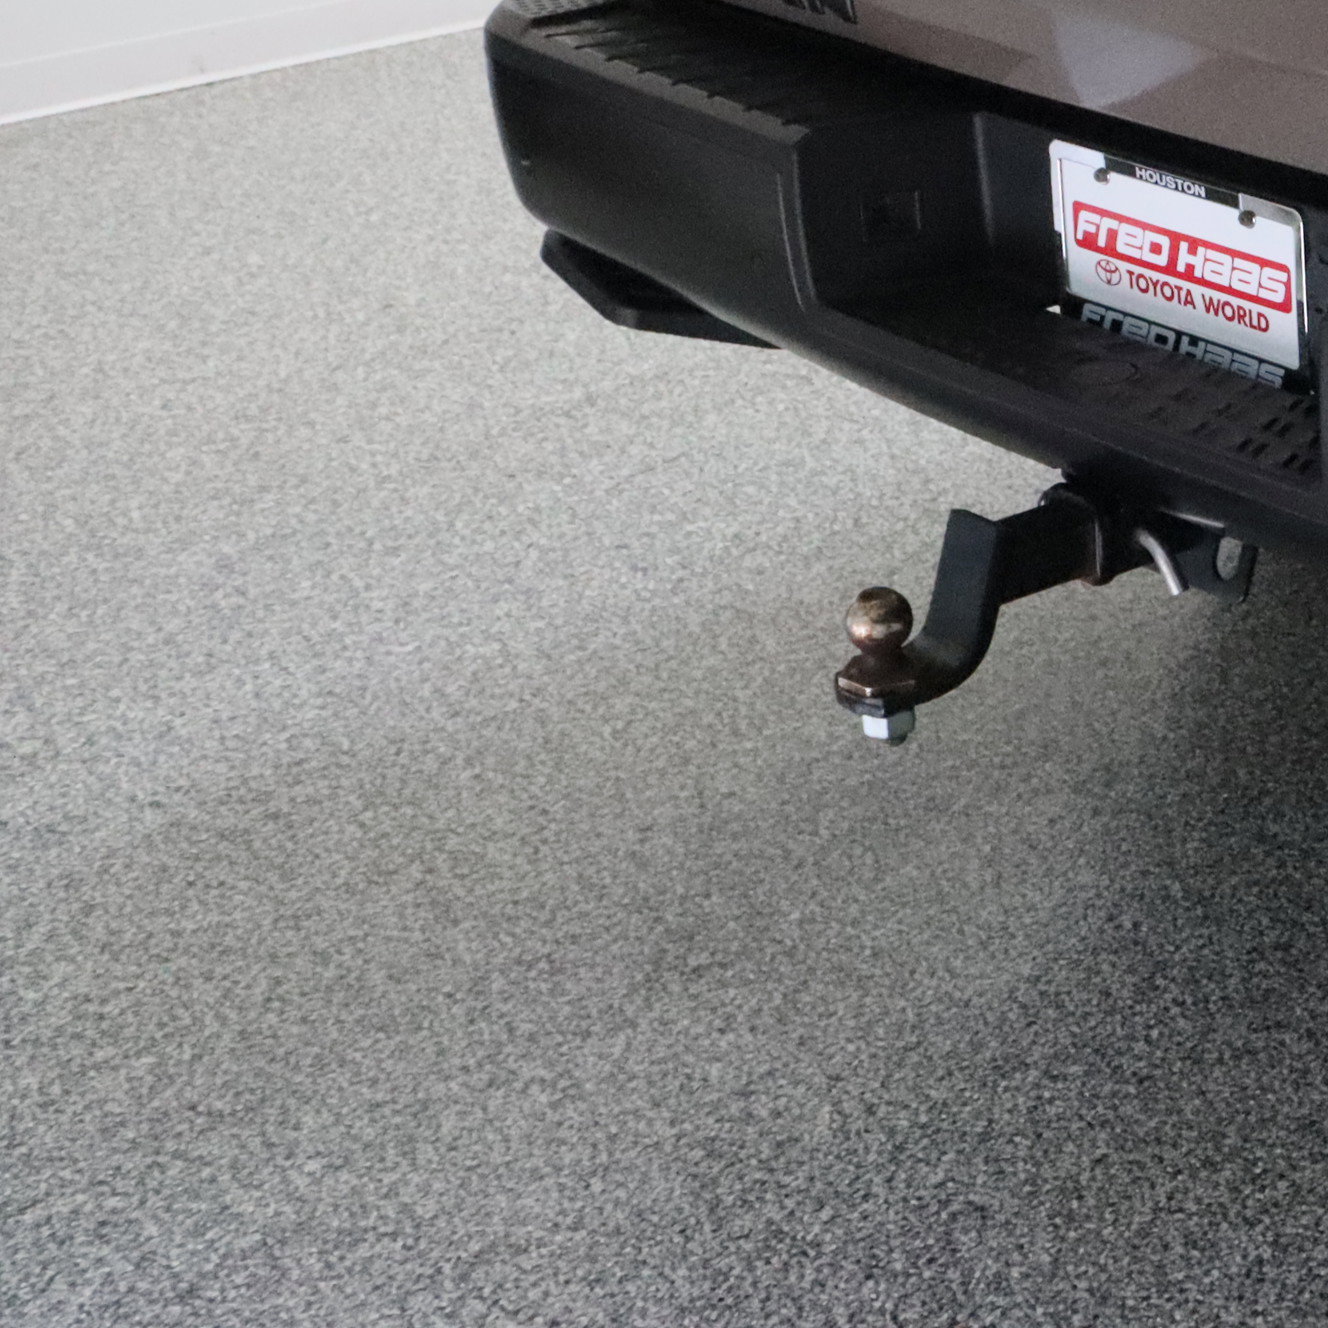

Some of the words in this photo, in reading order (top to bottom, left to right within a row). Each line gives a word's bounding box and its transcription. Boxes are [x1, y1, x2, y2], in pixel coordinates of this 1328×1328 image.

[1135, 167, 1206, 199] HOUSTON
[1126, 269, 1196, 310] TOYOTA
[1202, 293, 1270, 334] WORLD
